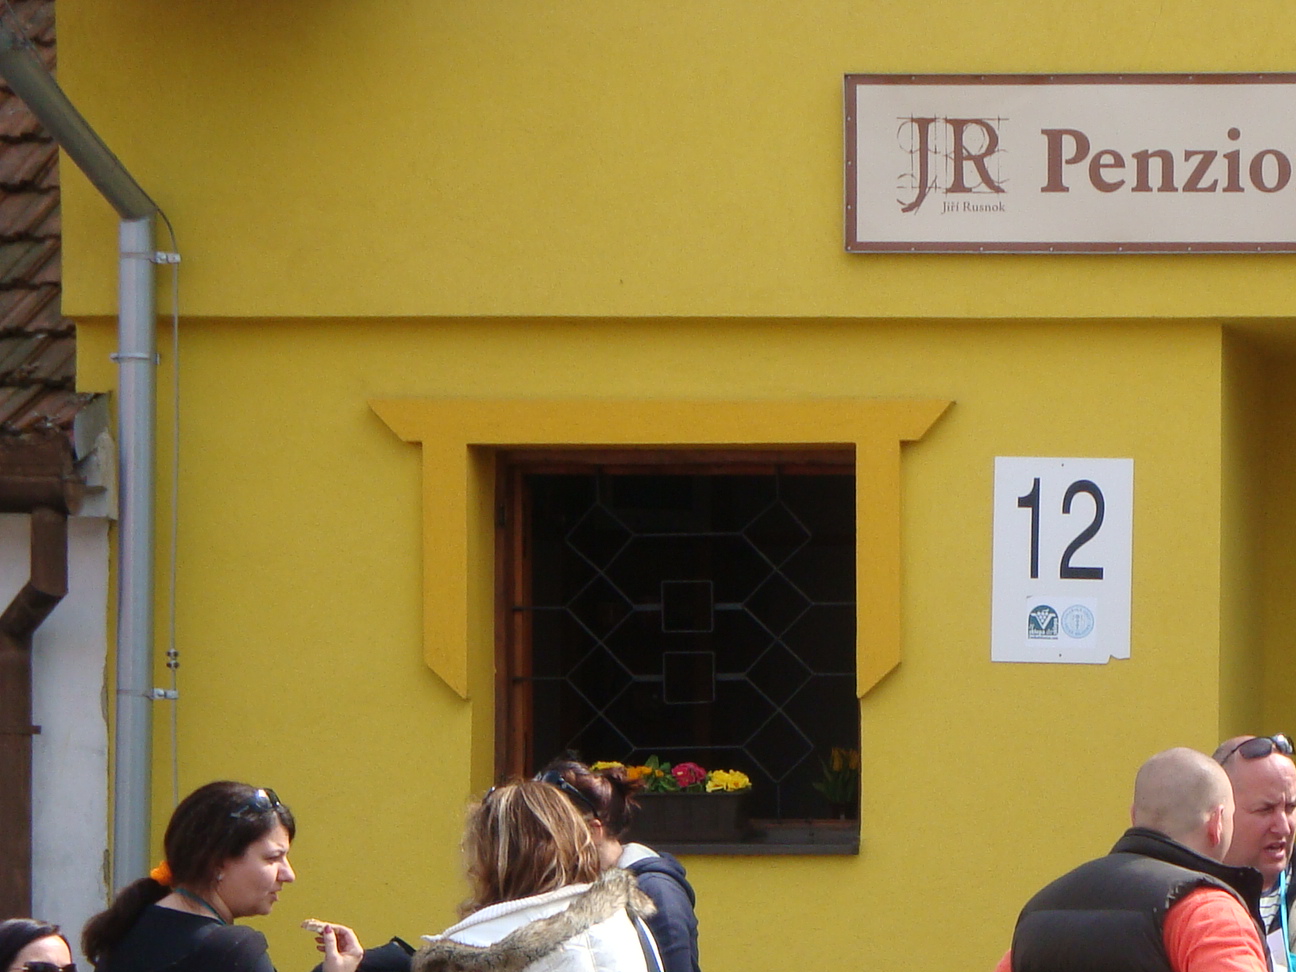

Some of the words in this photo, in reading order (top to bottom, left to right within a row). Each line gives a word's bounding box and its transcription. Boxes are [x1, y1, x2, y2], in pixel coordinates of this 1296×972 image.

[941, 201, 960, 214] Jiří
[962, 201, 1006, 213] Rusnok
[1017, 477, 1106, 580] 12
